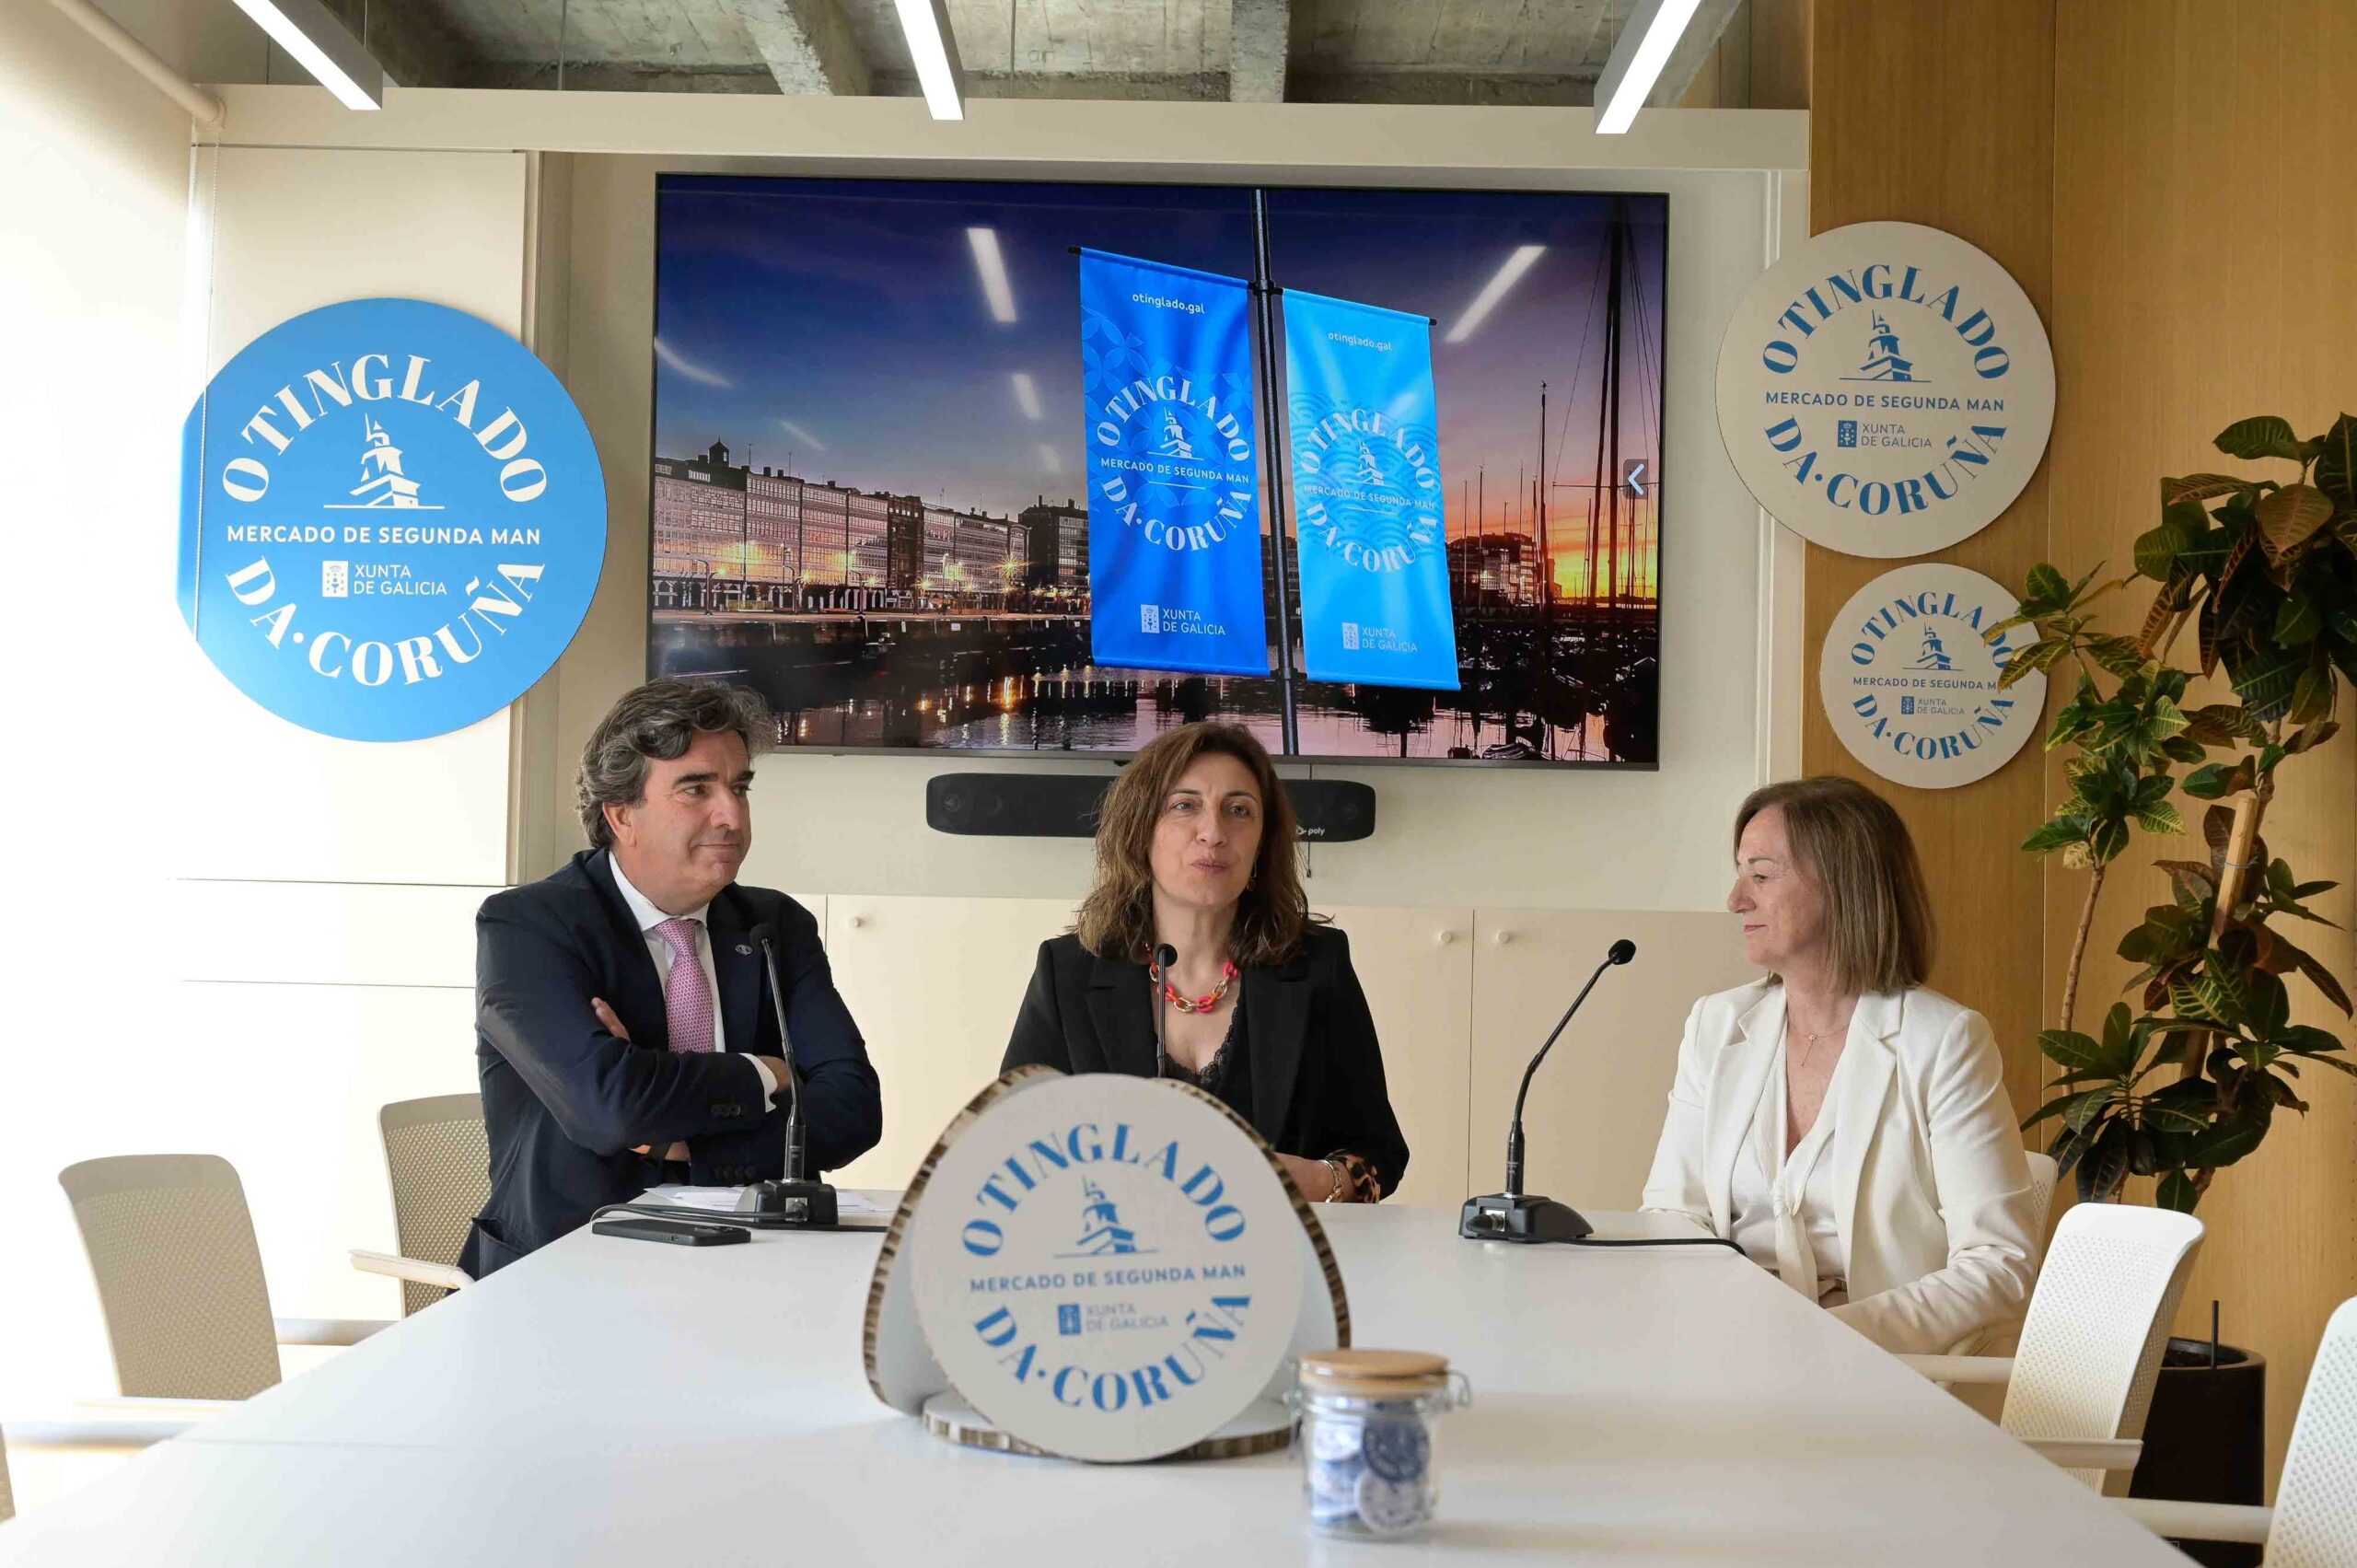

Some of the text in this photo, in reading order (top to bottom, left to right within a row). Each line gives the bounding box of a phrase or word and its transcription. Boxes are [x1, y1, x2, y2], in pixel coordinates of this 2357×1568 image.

[1132, 293, 1205, 314] otinglado.gal
[1328, 331, 1392, 352] otinglado.gal
[1765, 391, 2004, 412] MERCADO DE SEGUNDA MAN
[1862, 424, 1906, 435] XUNTA
[1862, 436, 1933, 448] DE GALICIA
[1100, 457, 1249, 483] MERCADO DE SEGUNDA MAN
[1304, 485, 1435, 509] MERCADO DE SEGUNDA MAN
[227, 525, 540, 545] MERCADO DE SEGUNDA MAN
[354, 563, 412, 579] XUNTA
[354, 580, 447, 596] DE GALICIA
[1162, 609, 1202, 621] XUNTA
[1162, 622, 1226, 636] DE GALICIA
[1362, 626, 1397, 638] XUNTA
[1362, 638, 1418, 653] DE GALICIA
[1852, 677, 1909, 688] MERCADO
[1912, 679, 1926, 688] DE
[1930, 679, 1983, 690] SEGUNDA
[1917, 698, 1947, 706] XUNTA
[1931, 706, 1965, 715] GALICIA
[1307, 827, 1326, 837] poly
[970, 1264, 1247, 1292] MERCADO DE SEGUNDA MAN
[1086, 1303, 1136, 1317] XUNTA
[1086, 1315, 1169, 1331] DE GALICIA
